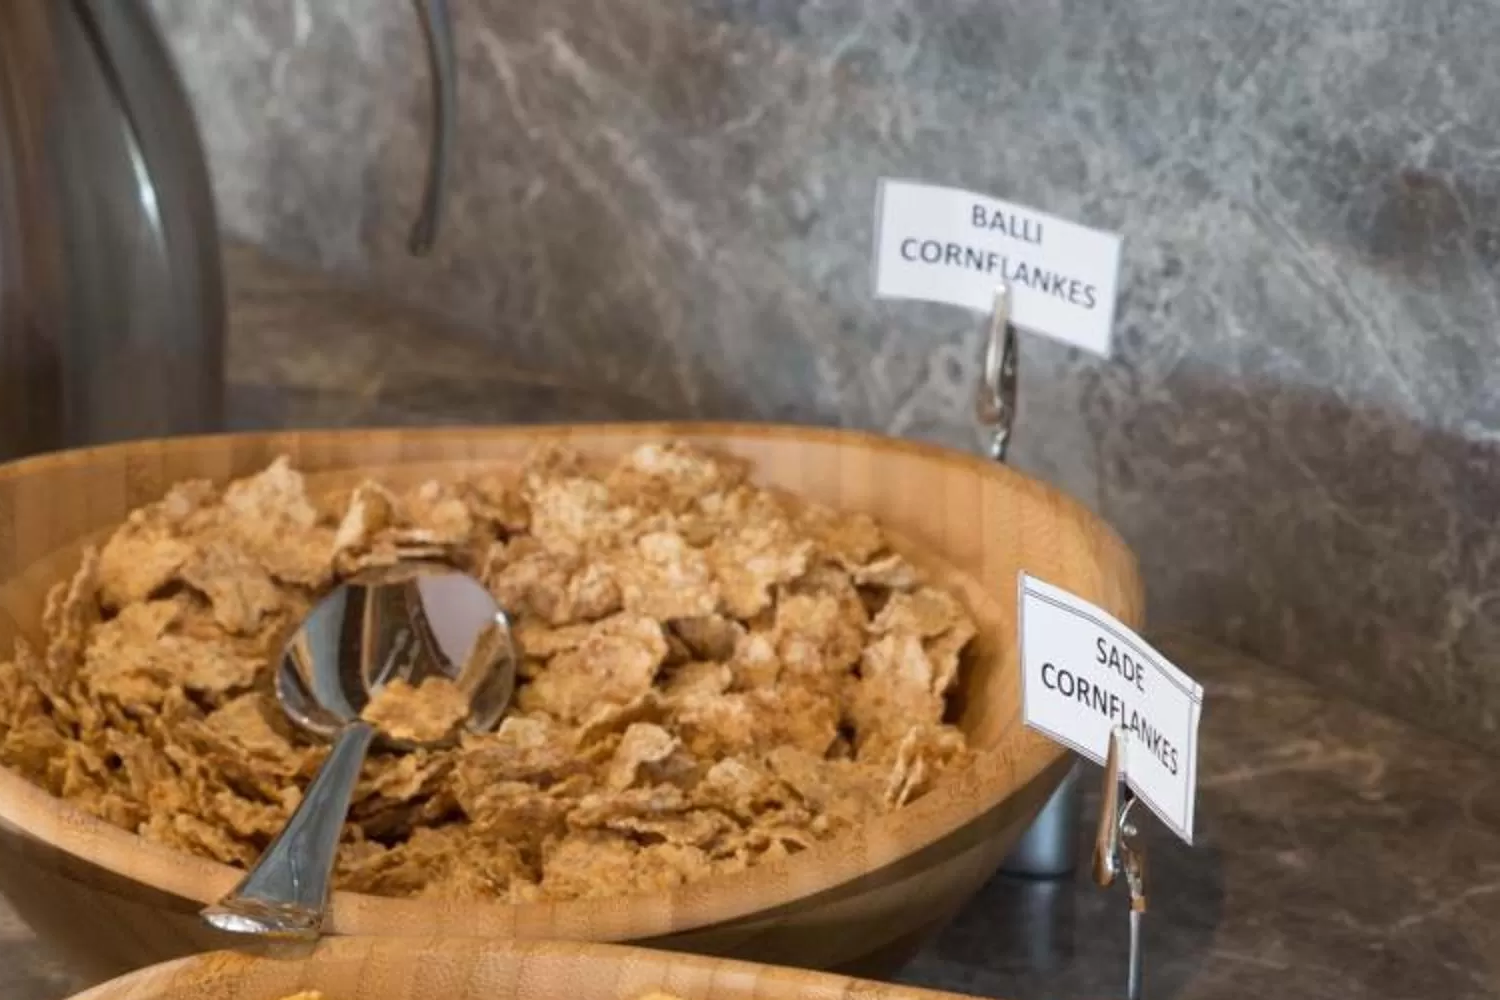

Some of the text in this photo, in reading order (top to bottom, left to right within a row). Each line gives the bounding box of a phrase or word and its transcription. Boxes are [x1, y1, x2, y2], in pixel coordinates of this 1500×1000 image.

[971, 204, 1043, 245] BALLI
[900, 236, 1097, 310] CORNFLANKES
[1096, 636, 1145, 692] SADE
[1040, 662, 1179, 776] CORNFLANKES
